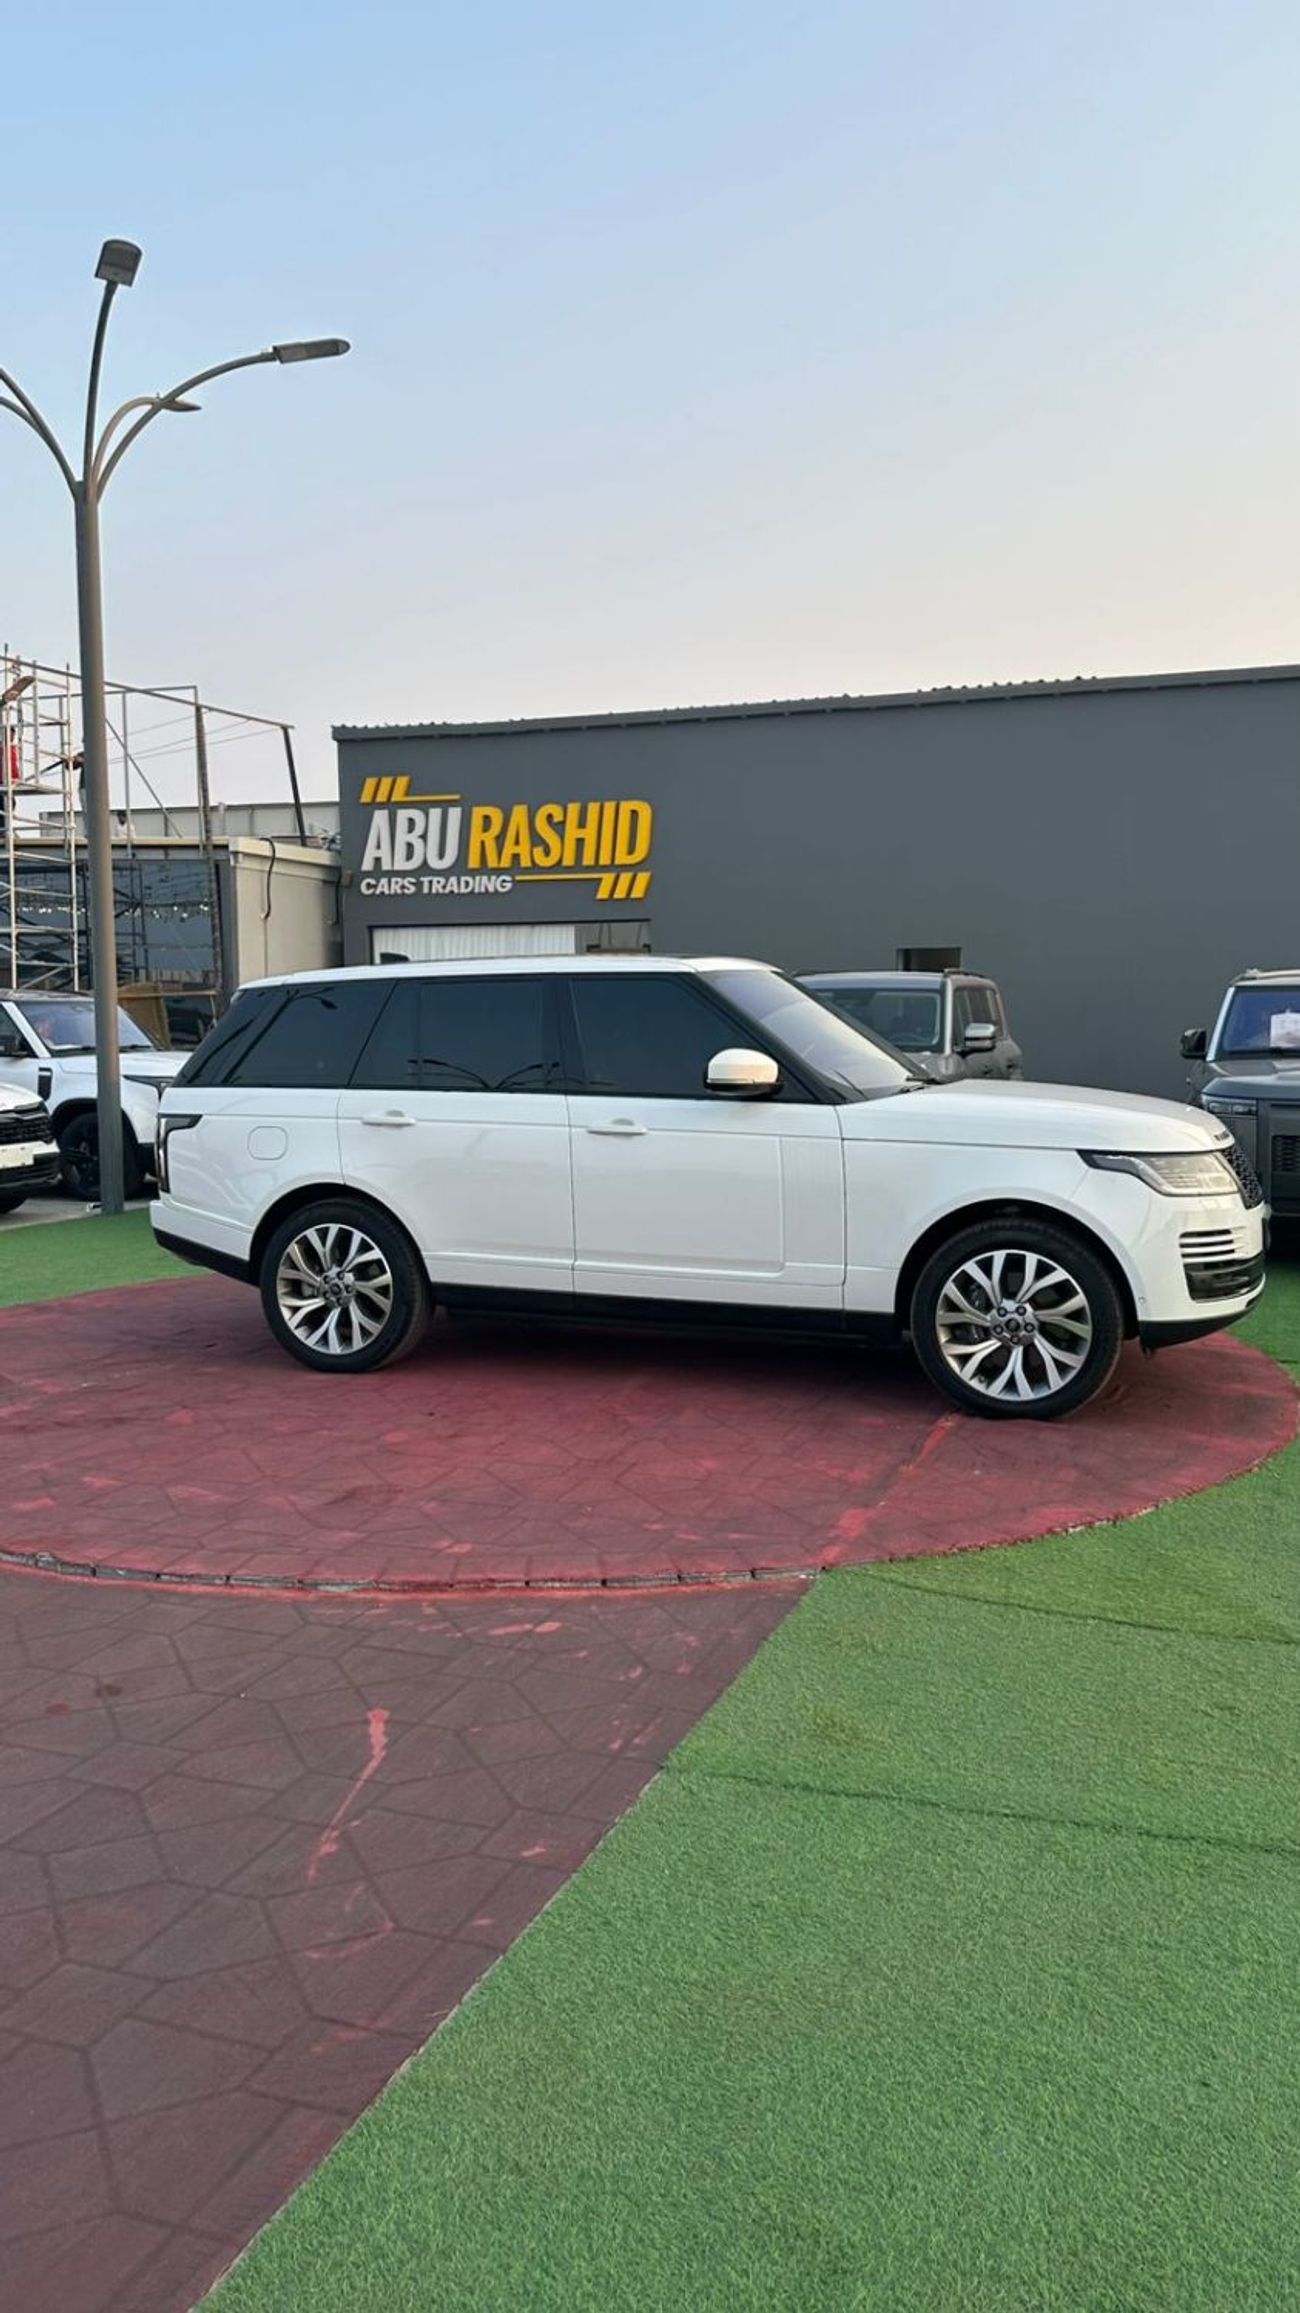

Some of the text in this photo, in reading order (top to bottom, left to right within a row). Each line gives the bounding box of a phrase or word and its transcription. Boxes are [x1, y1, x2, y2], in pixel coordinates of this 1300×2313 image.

[361, 800, 653, 871] ABU RASHID
[360, 875, 513, 895] CARS TRADING
